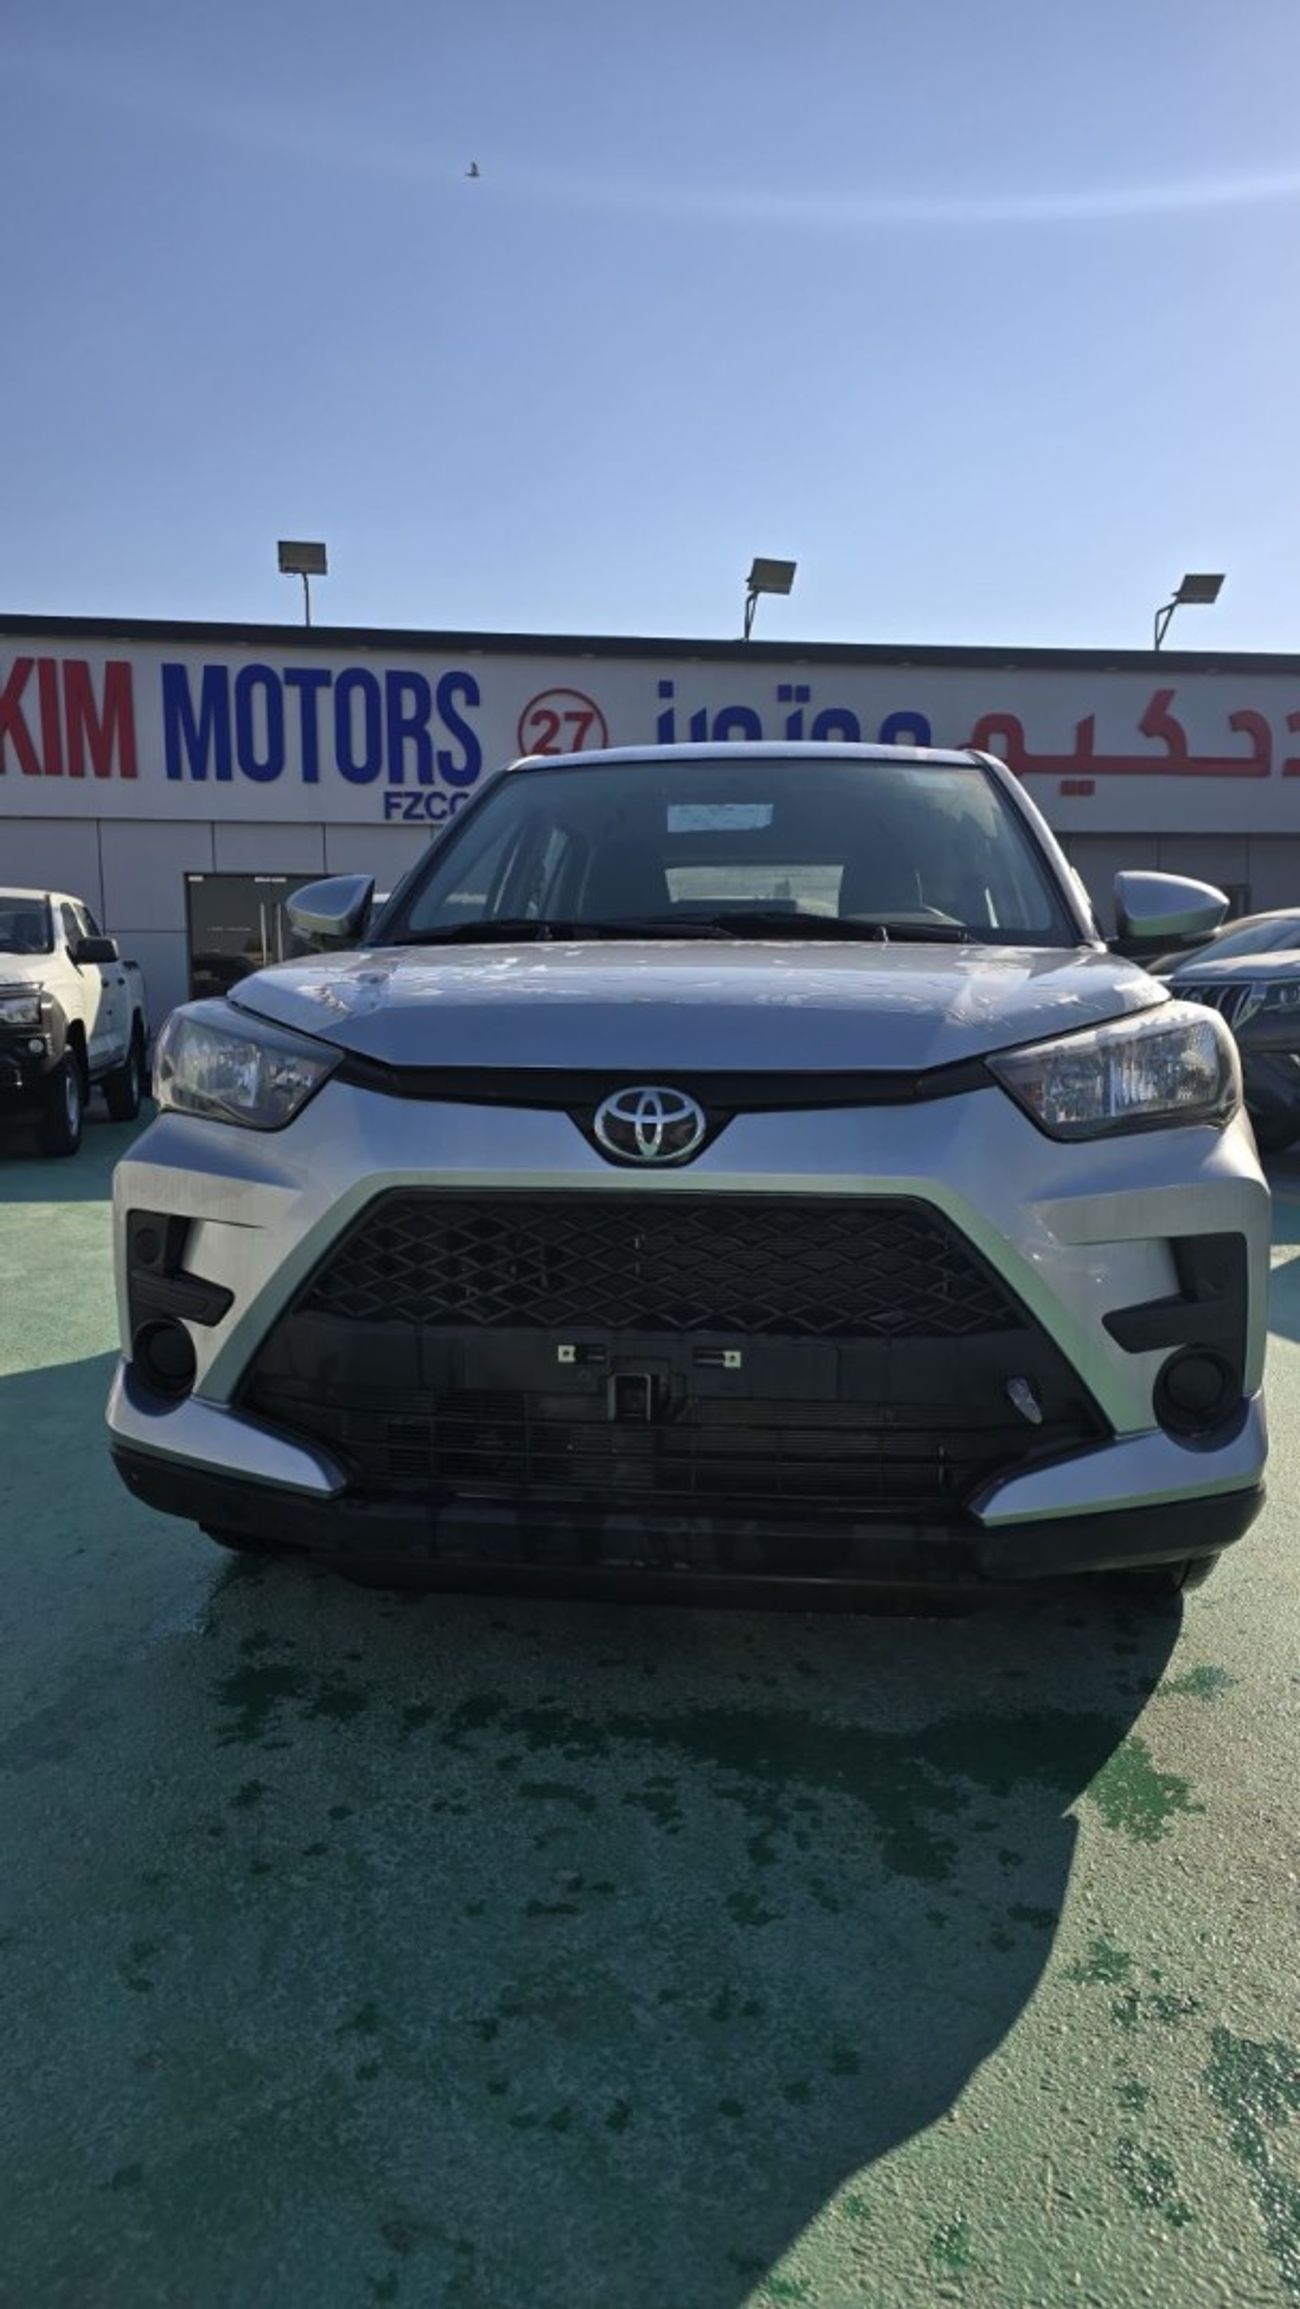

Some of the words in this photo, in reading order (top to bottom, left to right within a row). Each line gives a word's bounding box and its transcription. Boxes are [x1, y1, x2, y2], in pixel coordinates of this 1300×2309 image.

[0, 657, 138, 779] KIM
[161, 662, 482, 787] MOTORS
[529, 709, 595, 756] 27
